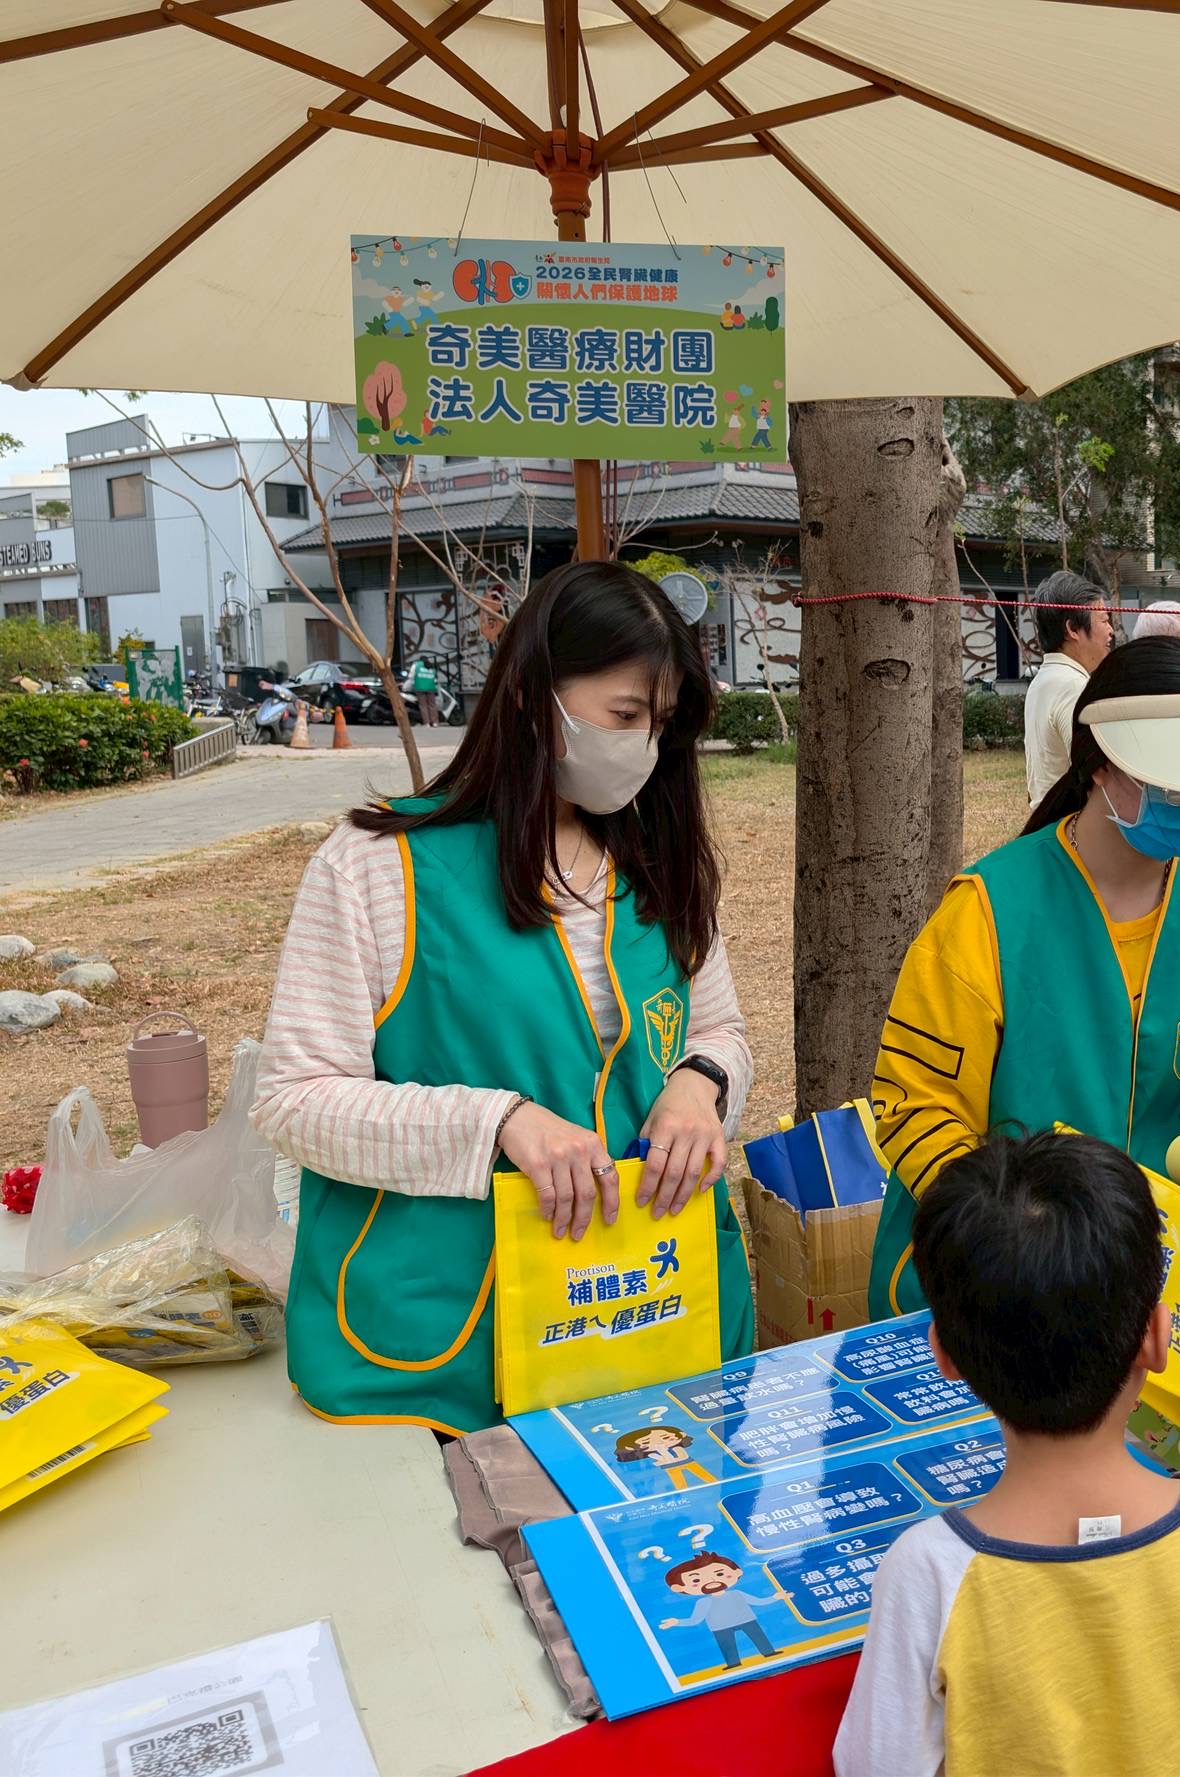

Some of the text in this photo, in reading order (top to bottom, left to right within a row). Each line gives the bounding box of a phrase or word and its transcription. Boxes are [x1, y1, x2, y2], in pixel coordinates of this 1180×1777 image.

[536, 282, 678, 301] 關懷人們保護地球
[428, 324, 715, 374] 奇美醫療財團
[428, 377, 716, 428] 法人奇美醫院
[31, 540, 52, 562] BUNS
[567, 1264, 615, 1279] Protison
[567, 1270, 647, 1306] 補體素
[865, 1333, 897, 1345] Q10
[722, 1371, 748, 1382] Q9
[916, 1369, 942, 1381] Q1
[768, 1407, 803, 1419] Q11
[954, 1439, 982, 1453] Q2
[786, 1481, 815, 1494] Q1
[747, 1486, 880, 1527] 高血壓會導致
[755, 1493, 903, 1538] 慢性腎病變嗎？
[836, 1539, 867, 1553] Q3
[819, 1587, 872, 1613] 臟的
